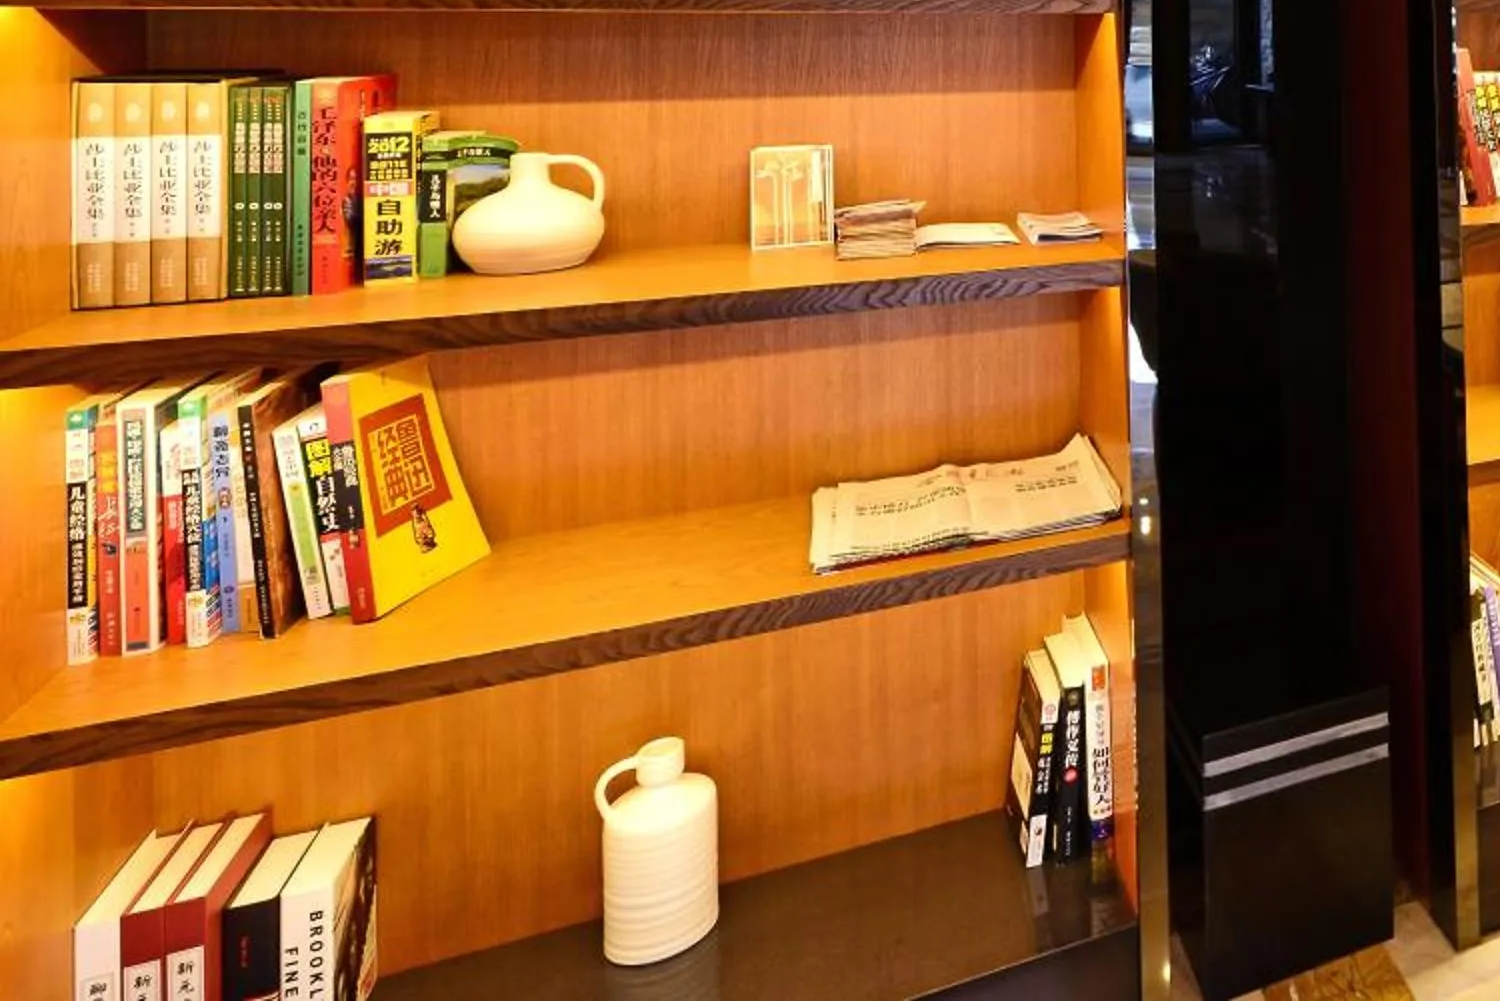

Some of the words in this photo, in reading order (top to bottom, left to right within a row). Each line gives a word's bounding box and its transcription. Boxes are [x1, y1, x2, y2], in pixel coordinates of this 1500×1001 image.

[368, 136, 409, 153] 2012
[374, 199, 403, 256] 自助游
[176, 960, 195, 1001] 新元
[285, 946, 299, 998] FINE
[309, 910, 324, 1000] BROOKL
